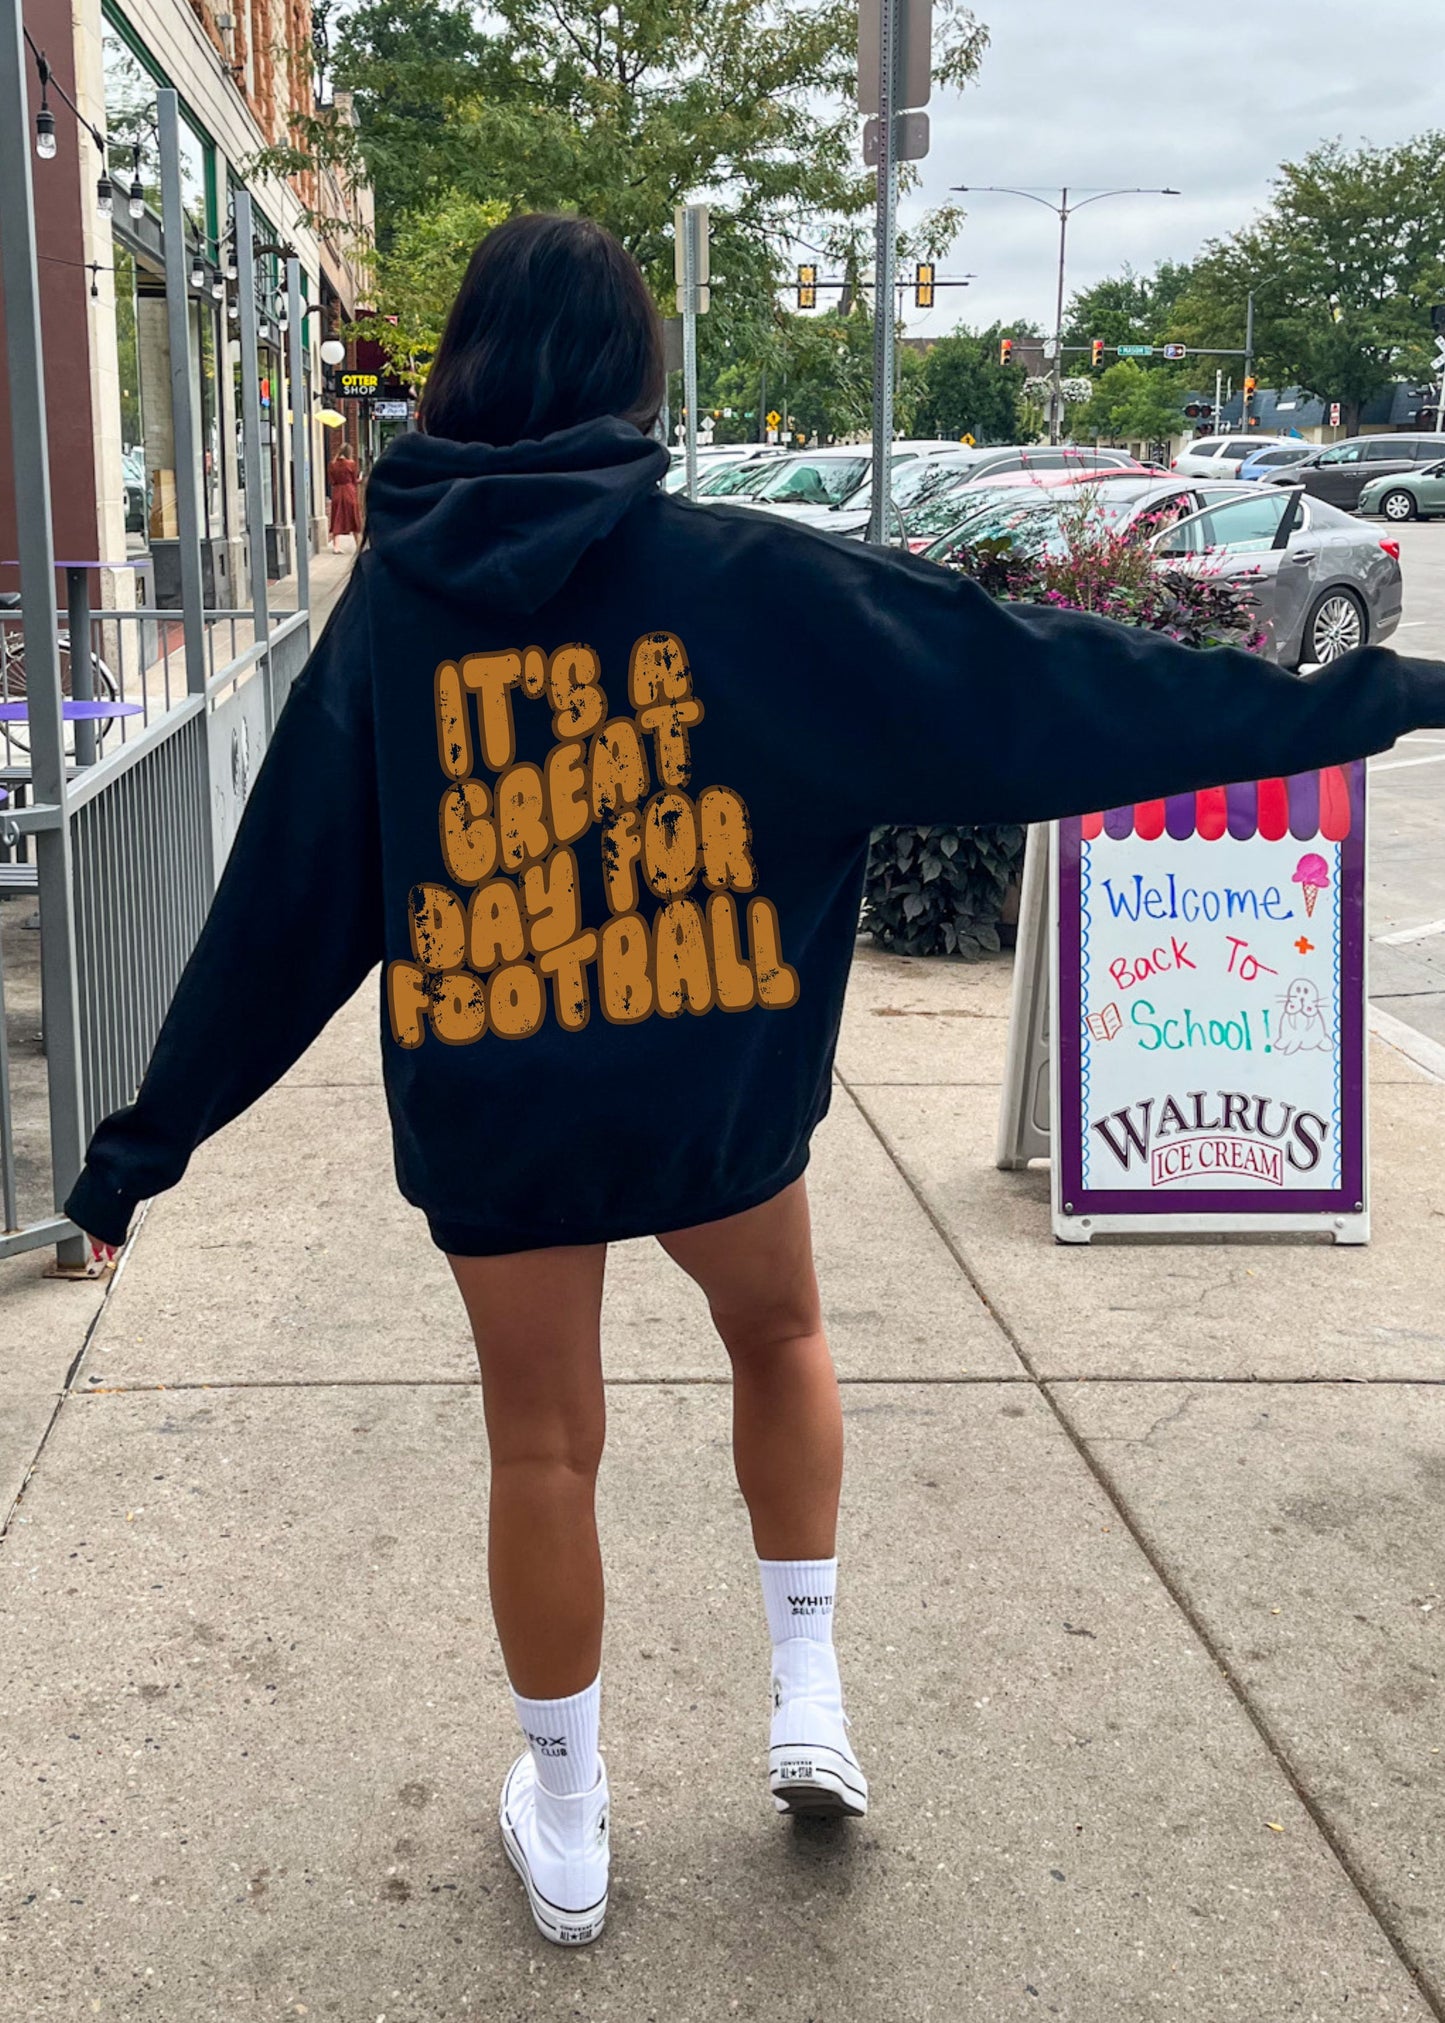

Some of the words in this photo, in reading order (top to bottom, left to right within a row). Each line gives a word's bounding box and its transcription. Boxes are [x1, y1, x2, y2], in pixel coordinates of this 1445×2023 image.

[341, 374, 378, 386] OTTER
[343, 386, 376, 395] SHOP
[434, 642, 608, 781] IT'S
[628, 631, 692, 708] A
[438, 698, 705, 886] GREAT
[408, 845, 582, 974] DAY
[602, 785, 759, 917] FOR
[1101, 873, 1294, 922] Welcome
[387, 887, 800, 1049] FOOTBALL
[1091, 1091, 1330, 1172] WALRUS
[1157, 1144, 1193, 1179] ICE
[1198, 1141, 1281, 1179] CREAM
[541, 1747, 567, 1757] CLUB
